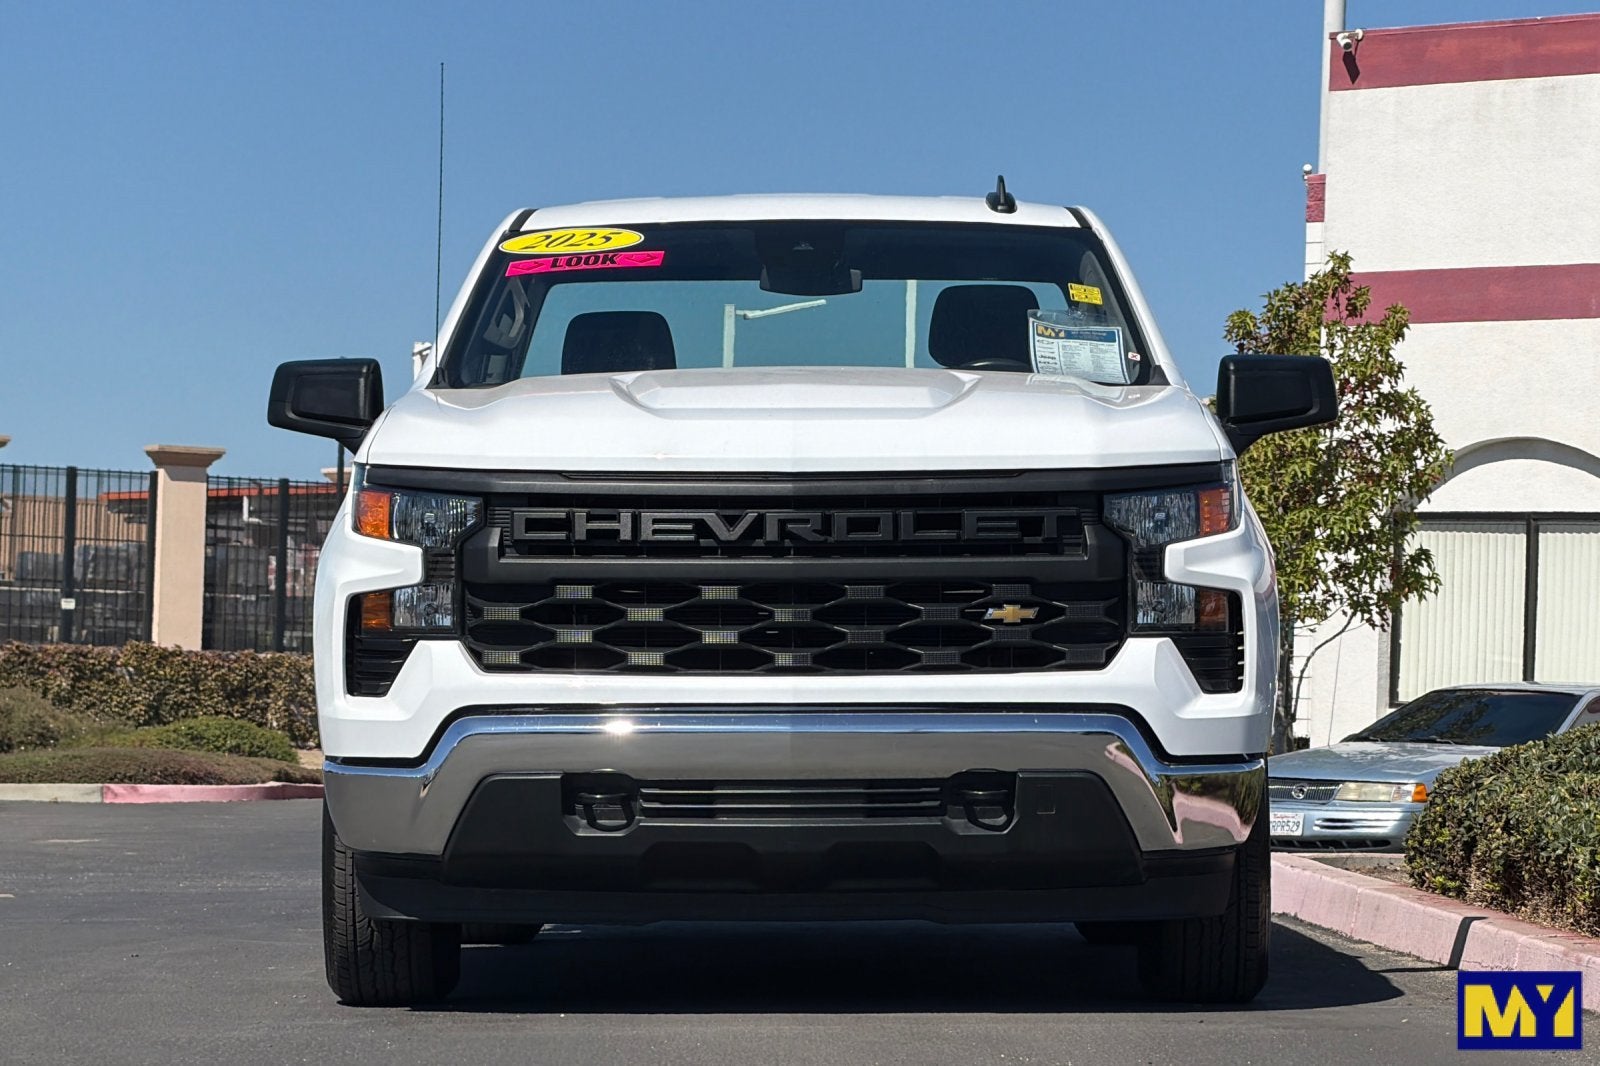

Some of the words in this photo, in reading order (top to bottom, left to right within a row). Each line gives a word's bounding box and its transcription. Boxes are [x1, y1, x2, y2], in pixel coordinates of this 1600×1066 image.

[517, 231, 623, 250] 2025
[550, 254, 619, 269] LOOK
[512, 508, 1078, 543] CHEVROLET
[1270, 820, 1300, 833] RPR529
